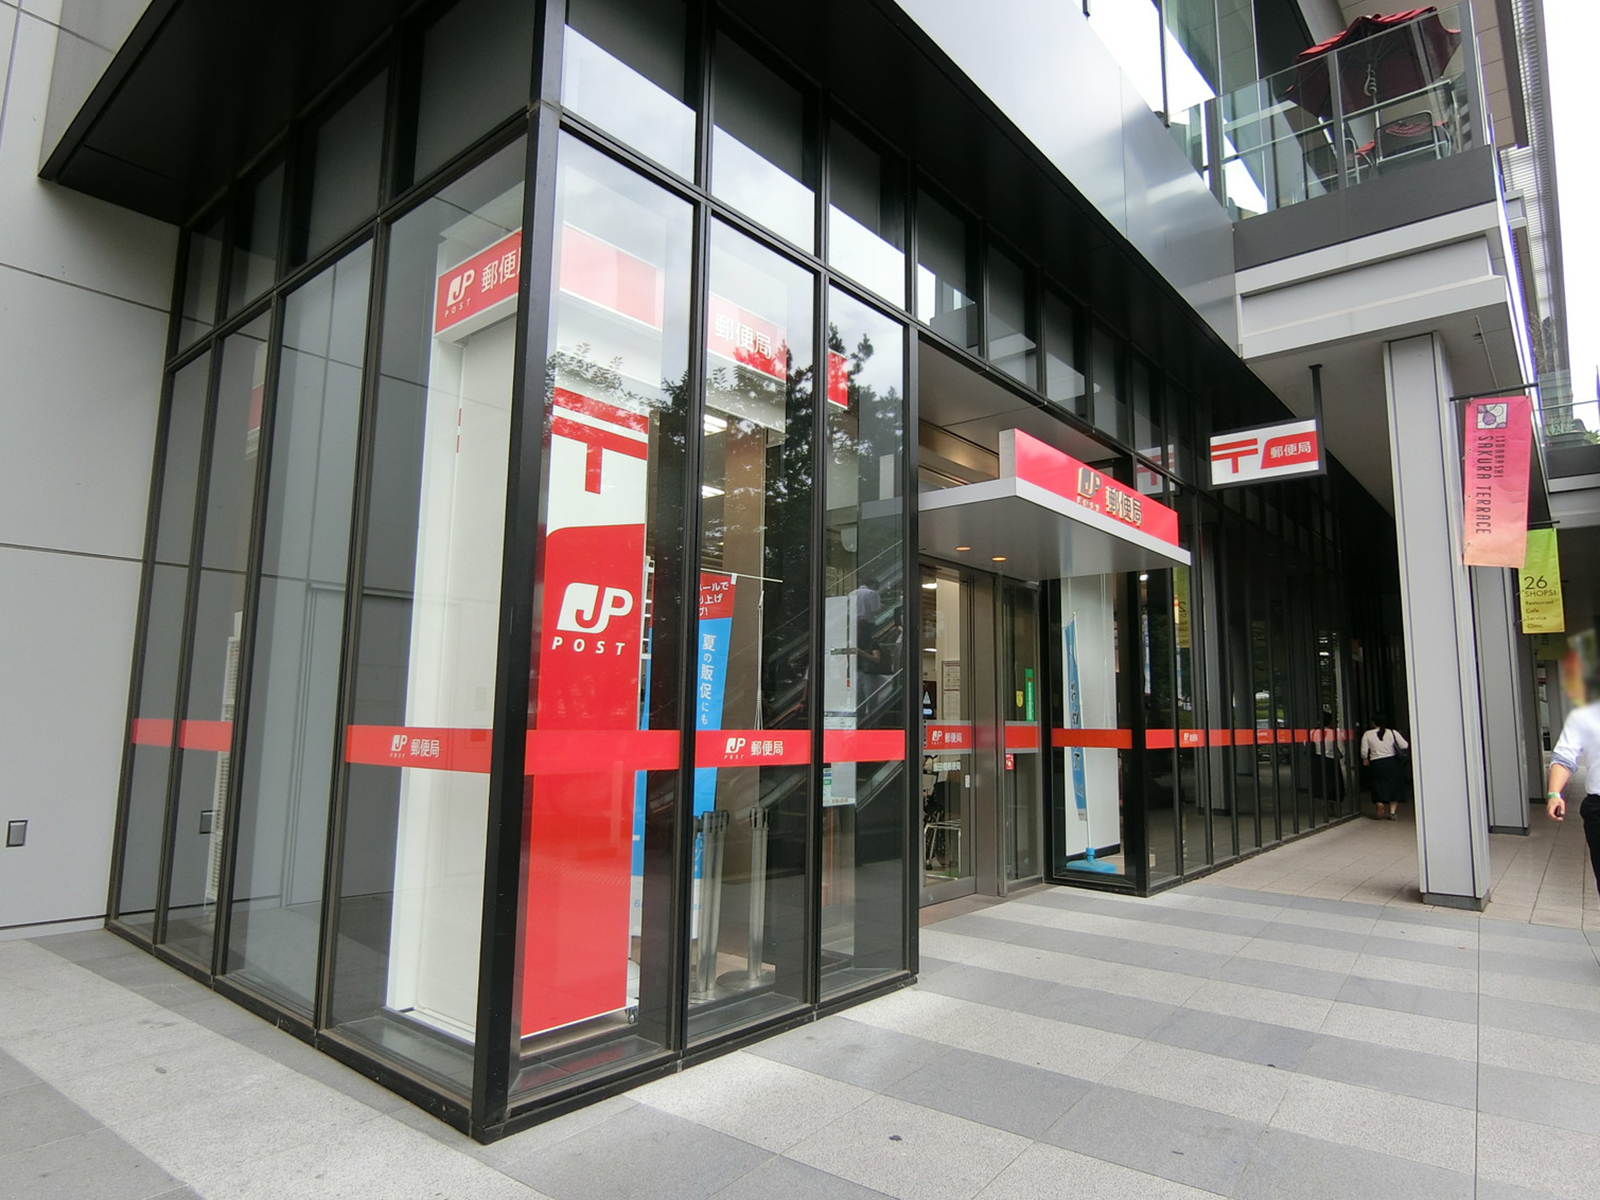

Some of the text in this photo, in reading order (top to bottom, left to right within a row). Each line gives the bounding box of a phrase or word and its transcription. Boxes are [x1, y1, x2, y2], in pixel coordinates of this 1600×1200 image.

[446, 246, 522, 307] JP 郵便
[444, 298, 471, 317] POST
[714, 313, 772, 360] 郵便局
[1270, 441, 1312, 459] 郵便局
[1475, 435, 1494, 534] SAKURA TERRACE
[1105, 485, 1143, 527] 郵便局
[1524, 575, 1548, 590] 26
[556, 582, 633, 634] JP
[551, 635, 626, 656] POST
[700, 633, 717, 726] 夏の販促にも
[391, 734, 440, 758] JP 郵便局
[725, 737, 784, 756] JP 郵便局
